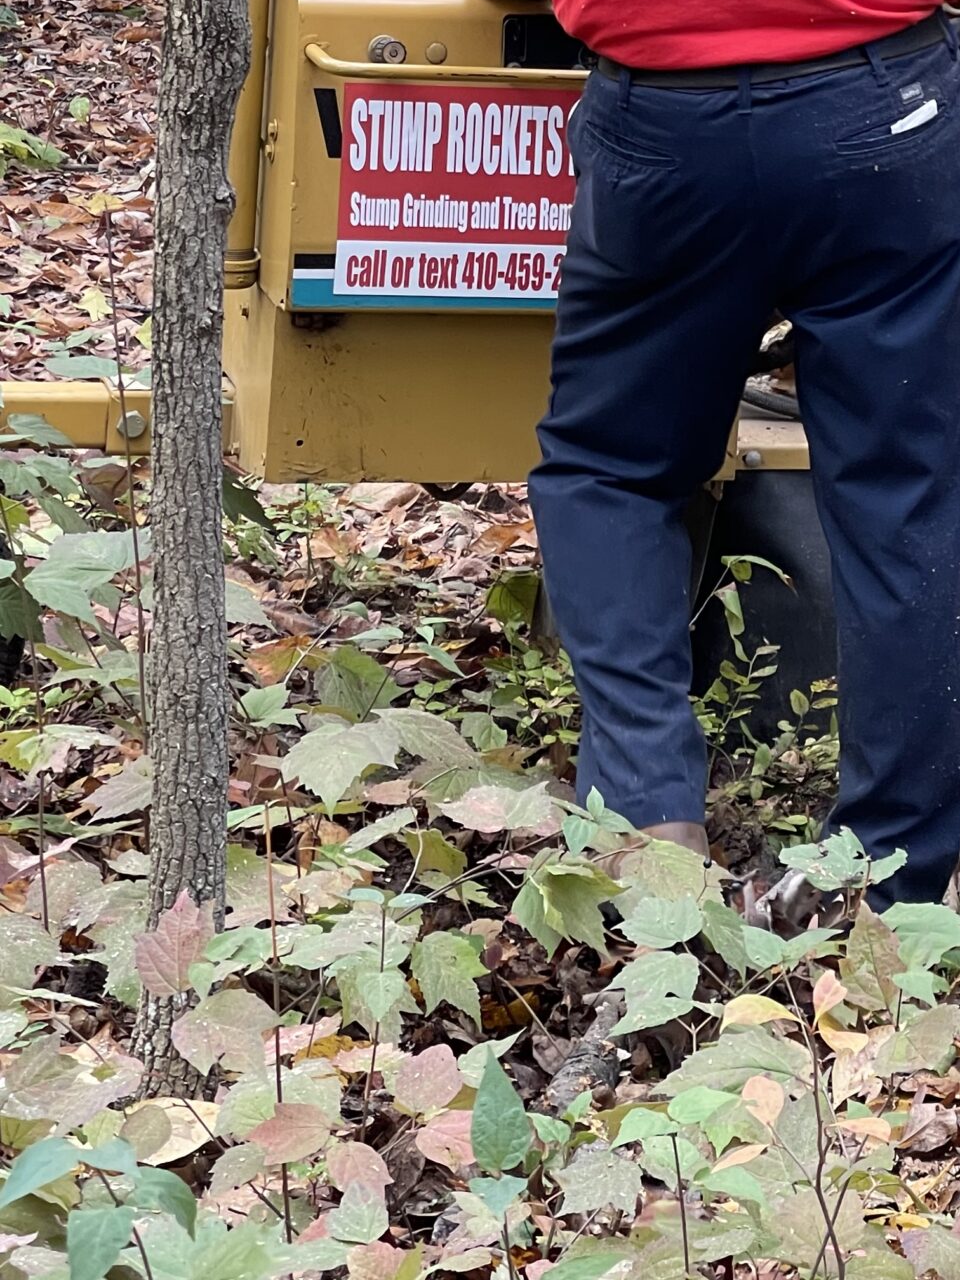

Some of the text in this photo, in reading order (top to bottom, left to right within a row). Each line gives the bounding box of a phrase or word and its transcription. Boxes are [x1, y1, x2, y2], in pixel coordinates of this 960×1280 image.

[350, 98, 443, 172] STUMP
[446, 102, 563, 177] ROCKETS
[350, 192, 400, 231] Stump
[403, 193, 468, 233] Grinding
[471, 196, 500, 230] and
[503, 196, 537, 231] Tree
[346, 250, 388, 288] call
[391, 255, 414, 288] or
[418, 254, 459, 289] text
